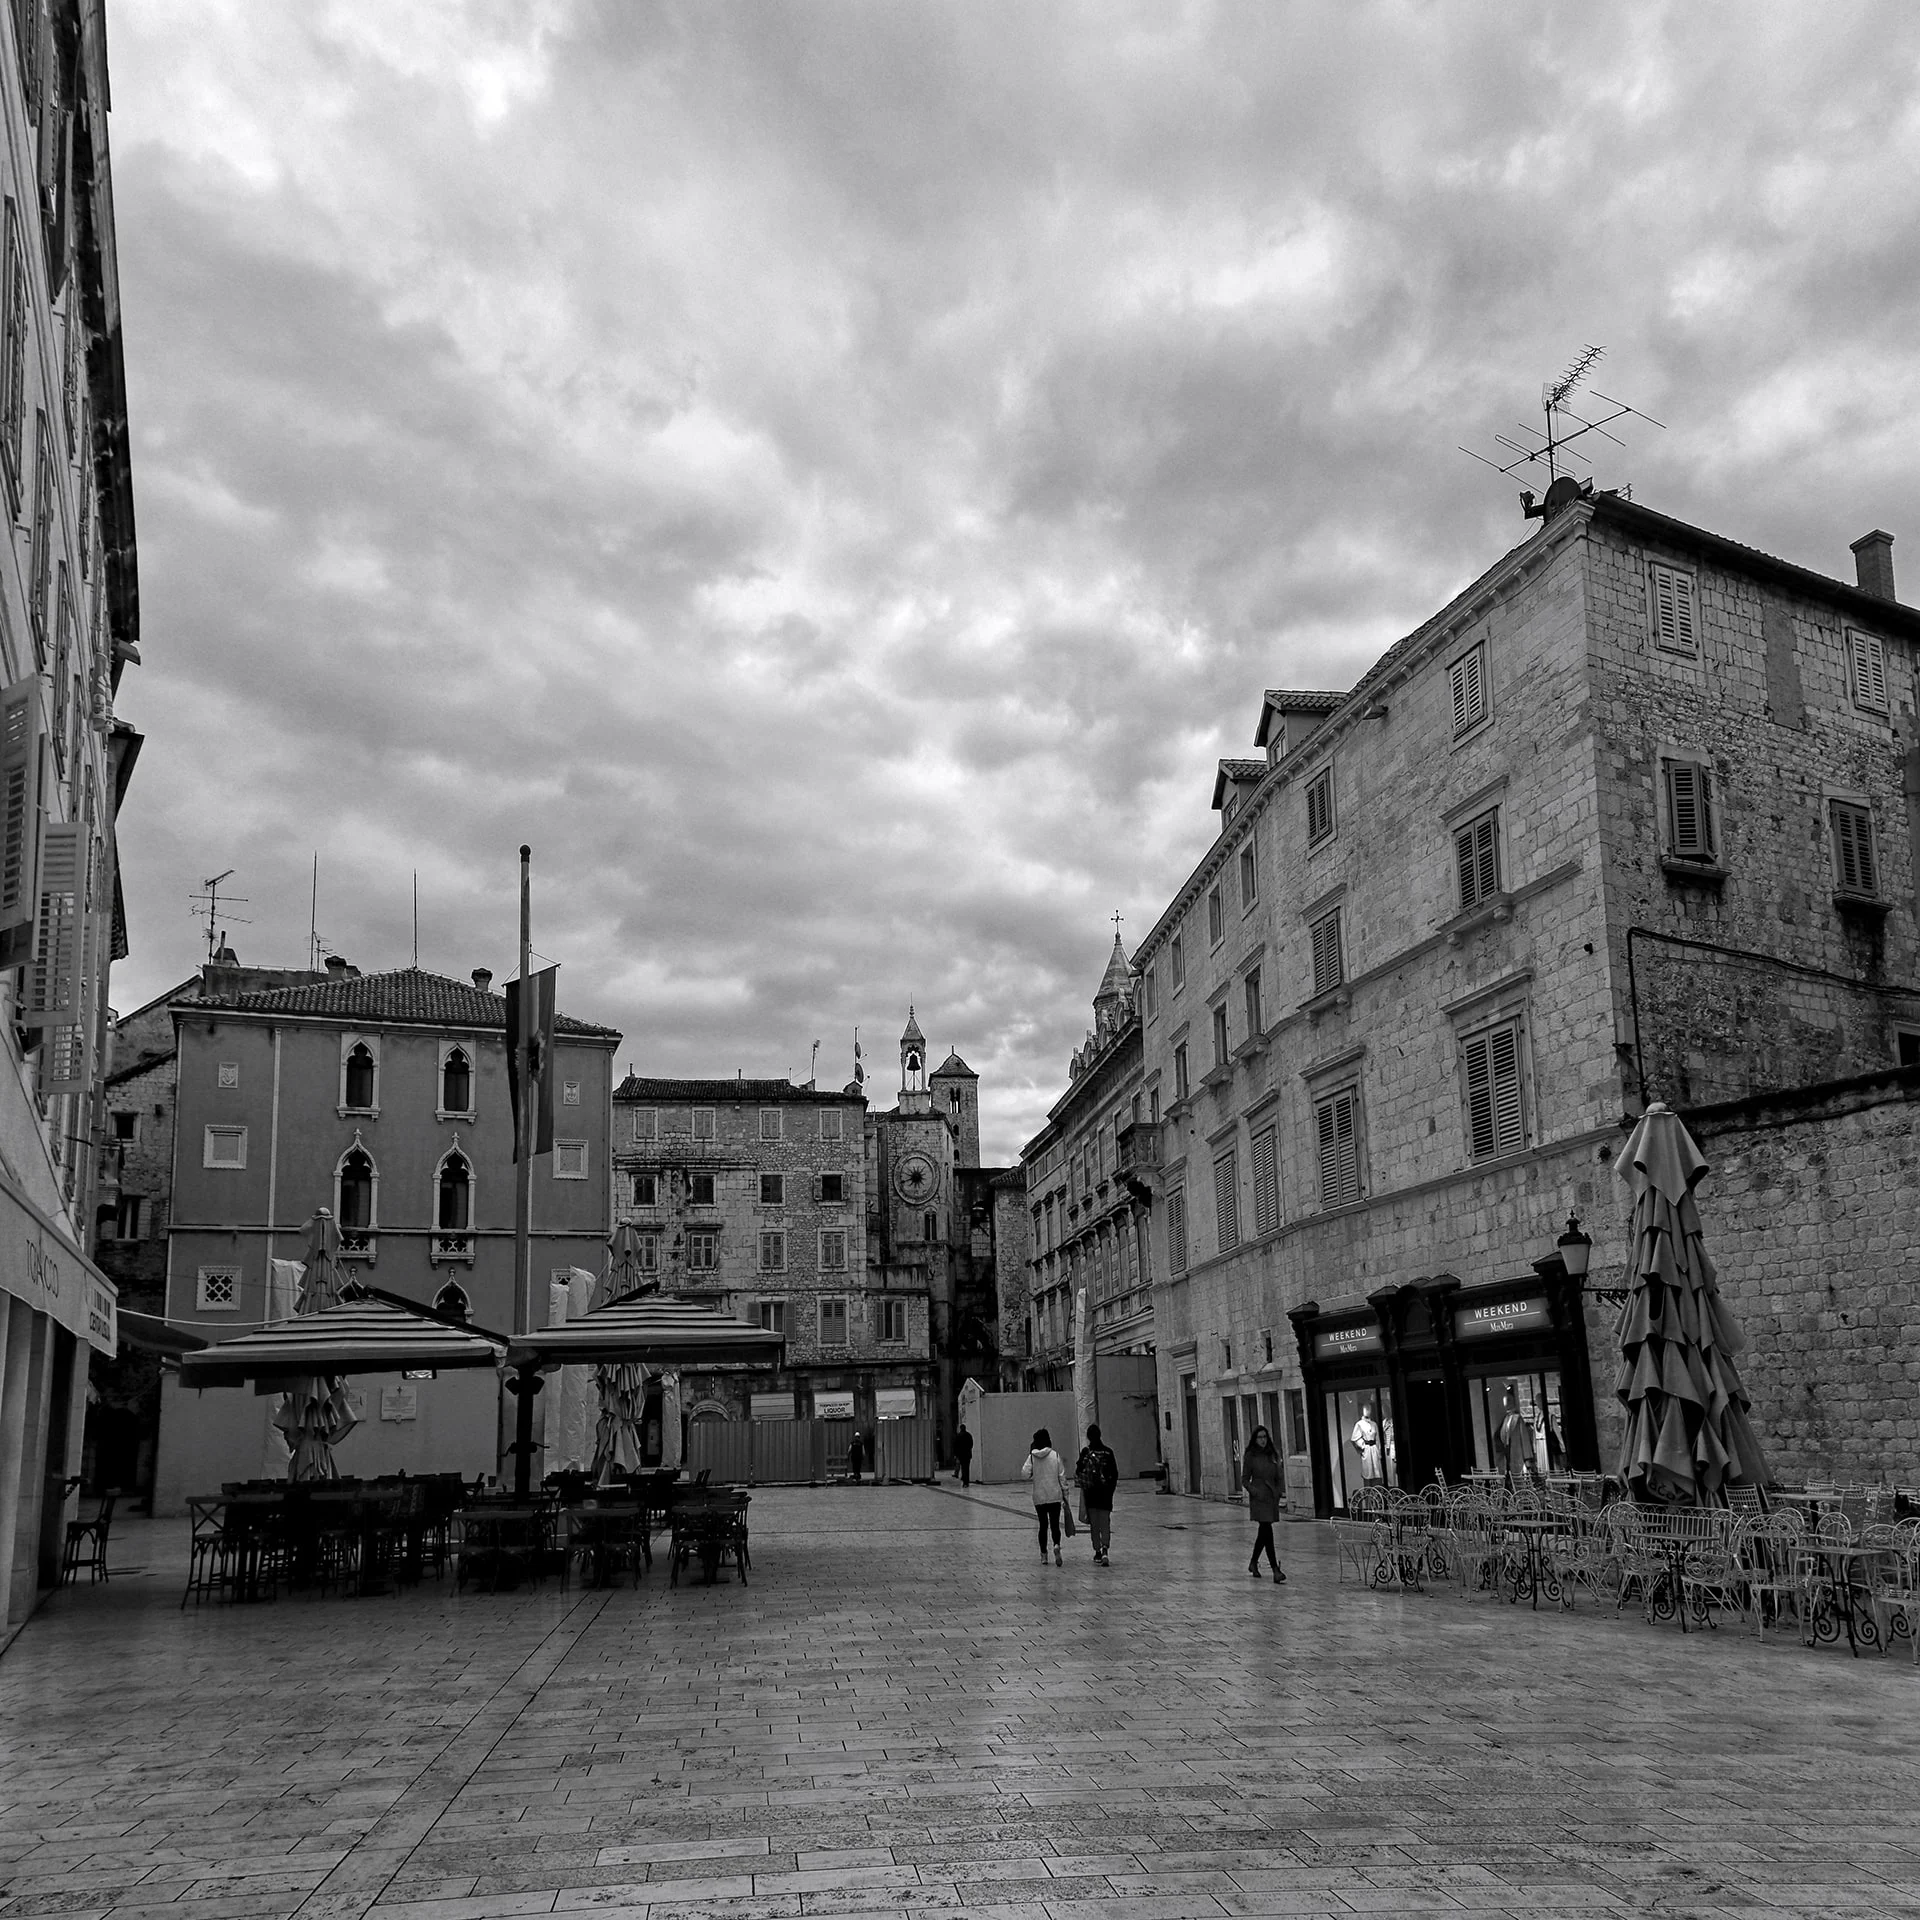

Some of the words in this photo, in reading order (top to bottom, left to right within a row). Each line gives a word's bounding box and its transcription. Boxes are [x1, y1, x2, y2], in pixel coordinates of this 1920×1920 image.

[1474, 1301, 1528, 1319] WEEKEND
[1329, 1328, 1367, 1341] WEEKEND
[823, 1406, 846, 1414] LIQUOR
